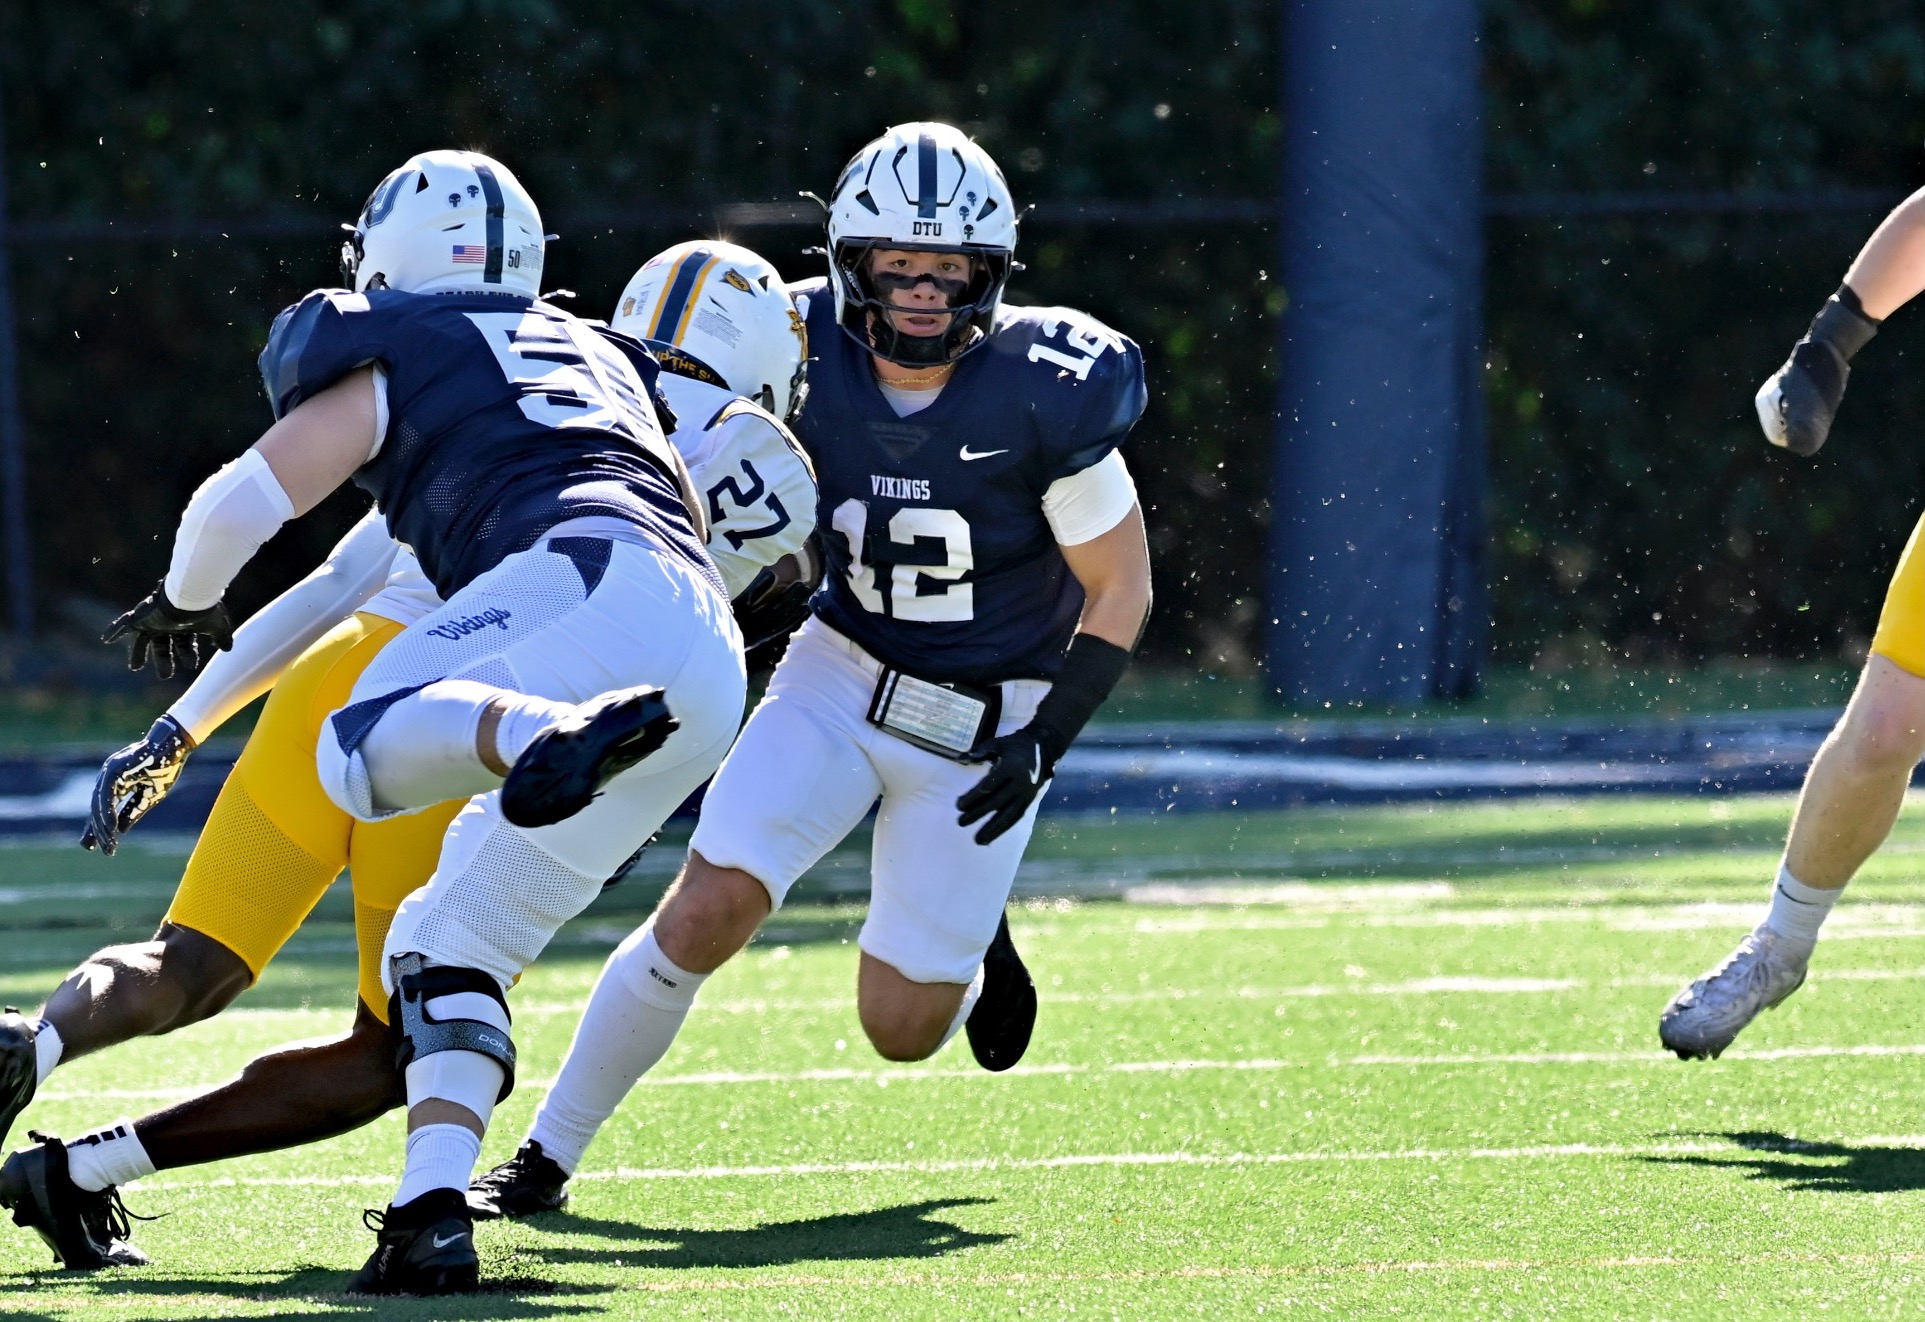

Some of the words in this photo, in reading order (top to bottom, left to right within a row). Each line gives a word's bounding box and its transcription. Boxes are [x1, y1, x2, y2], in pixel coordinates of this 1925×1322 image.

[912, 221, 942, 236] DTU
[508, 249, 521, 268] 50
[669, 355, 697, 371] THE
[1027, 319, 1127, 381] 12
[870, 474, 931, 501] VIKINGS
[706, 459, 791, 552] 27
[832, 497, 974, 623] 12
[426, 607, 512, 640] Vikings
